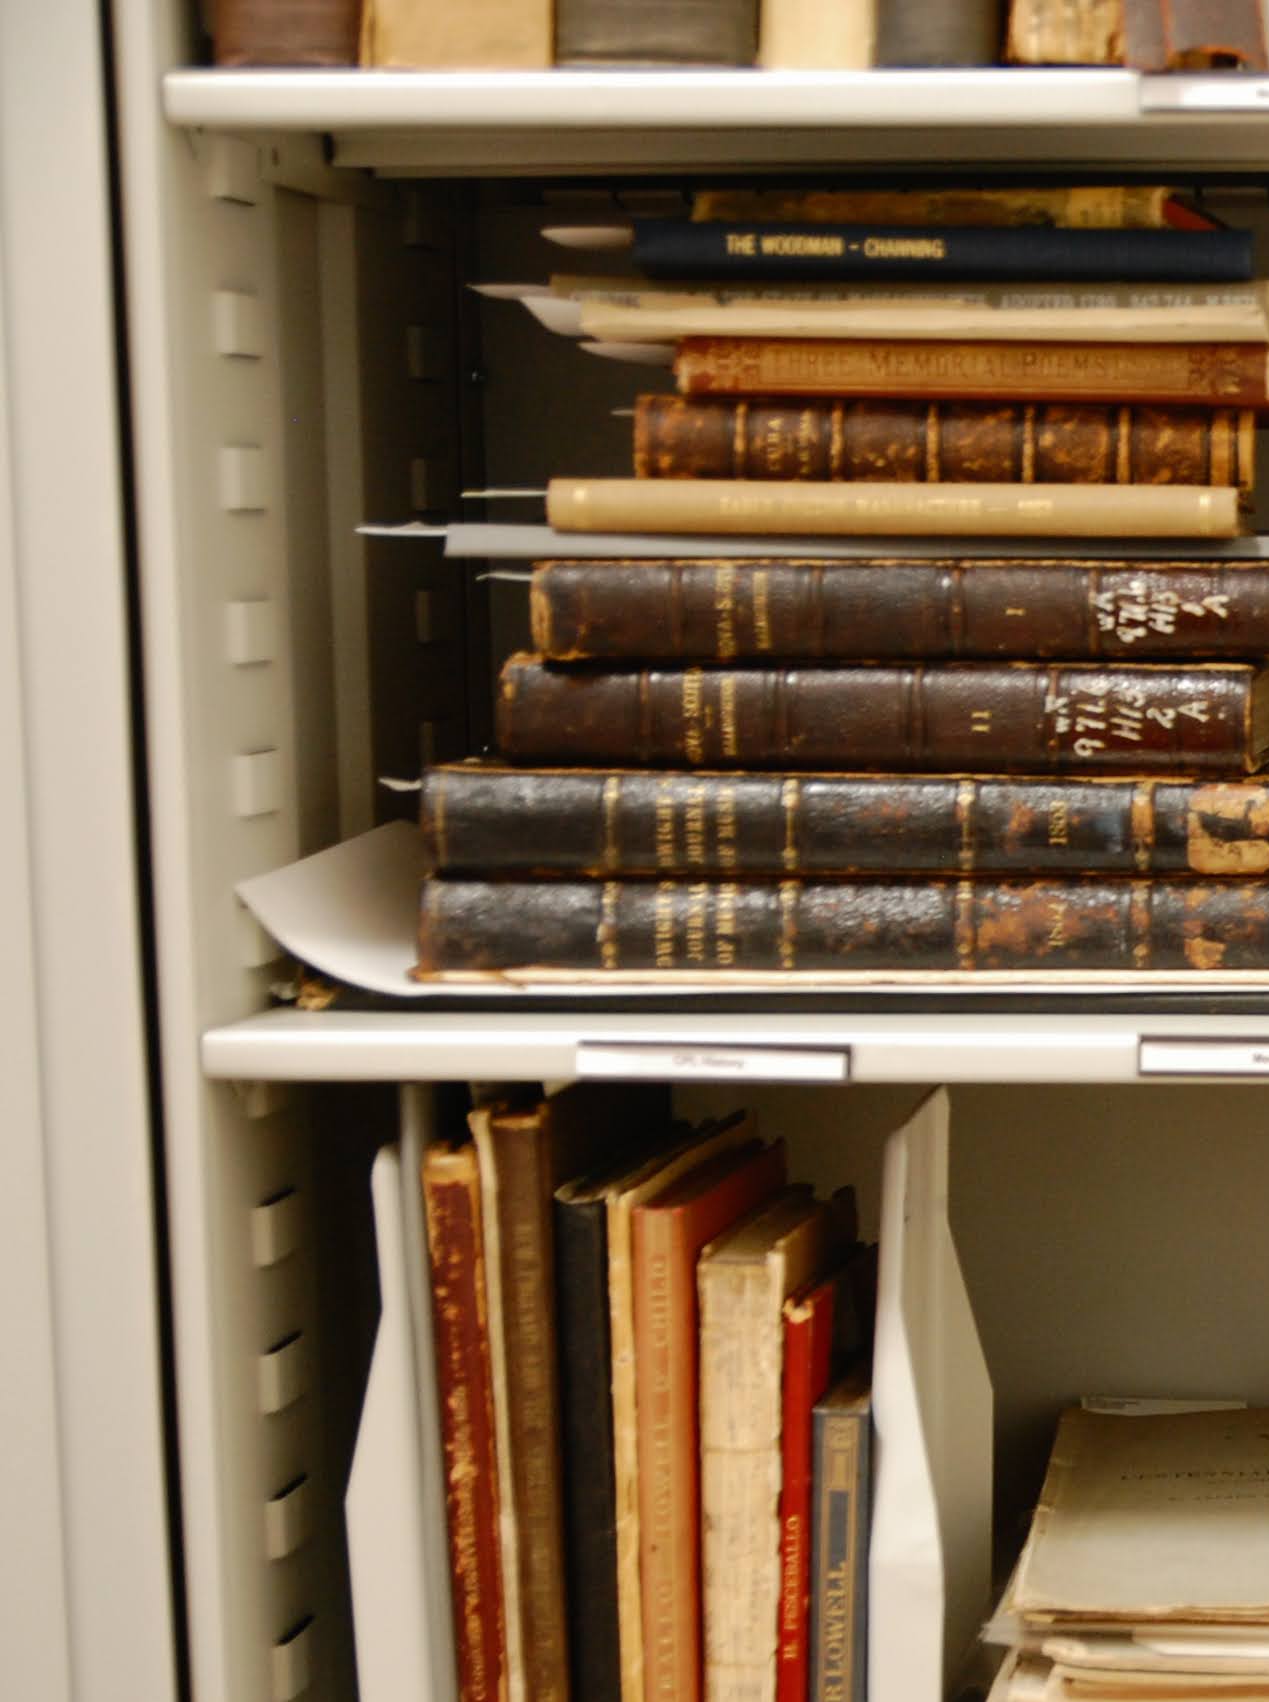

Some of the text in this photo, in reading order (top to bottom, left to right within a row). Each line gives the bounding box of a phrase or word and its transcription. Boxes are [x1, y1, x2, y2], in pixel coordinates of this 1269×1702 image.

[726, 234, 756, 255] THE
[760, 235, 844, 256] WOODMAN
[864, 236, 946, 259] CHANNING
[868, 350, 1011, 378] MEMORIAL
[1177, 700, 1210, 723] A
[685, 785, 706, 865] JOURNAL
[716, 940, 735, 965] OF
